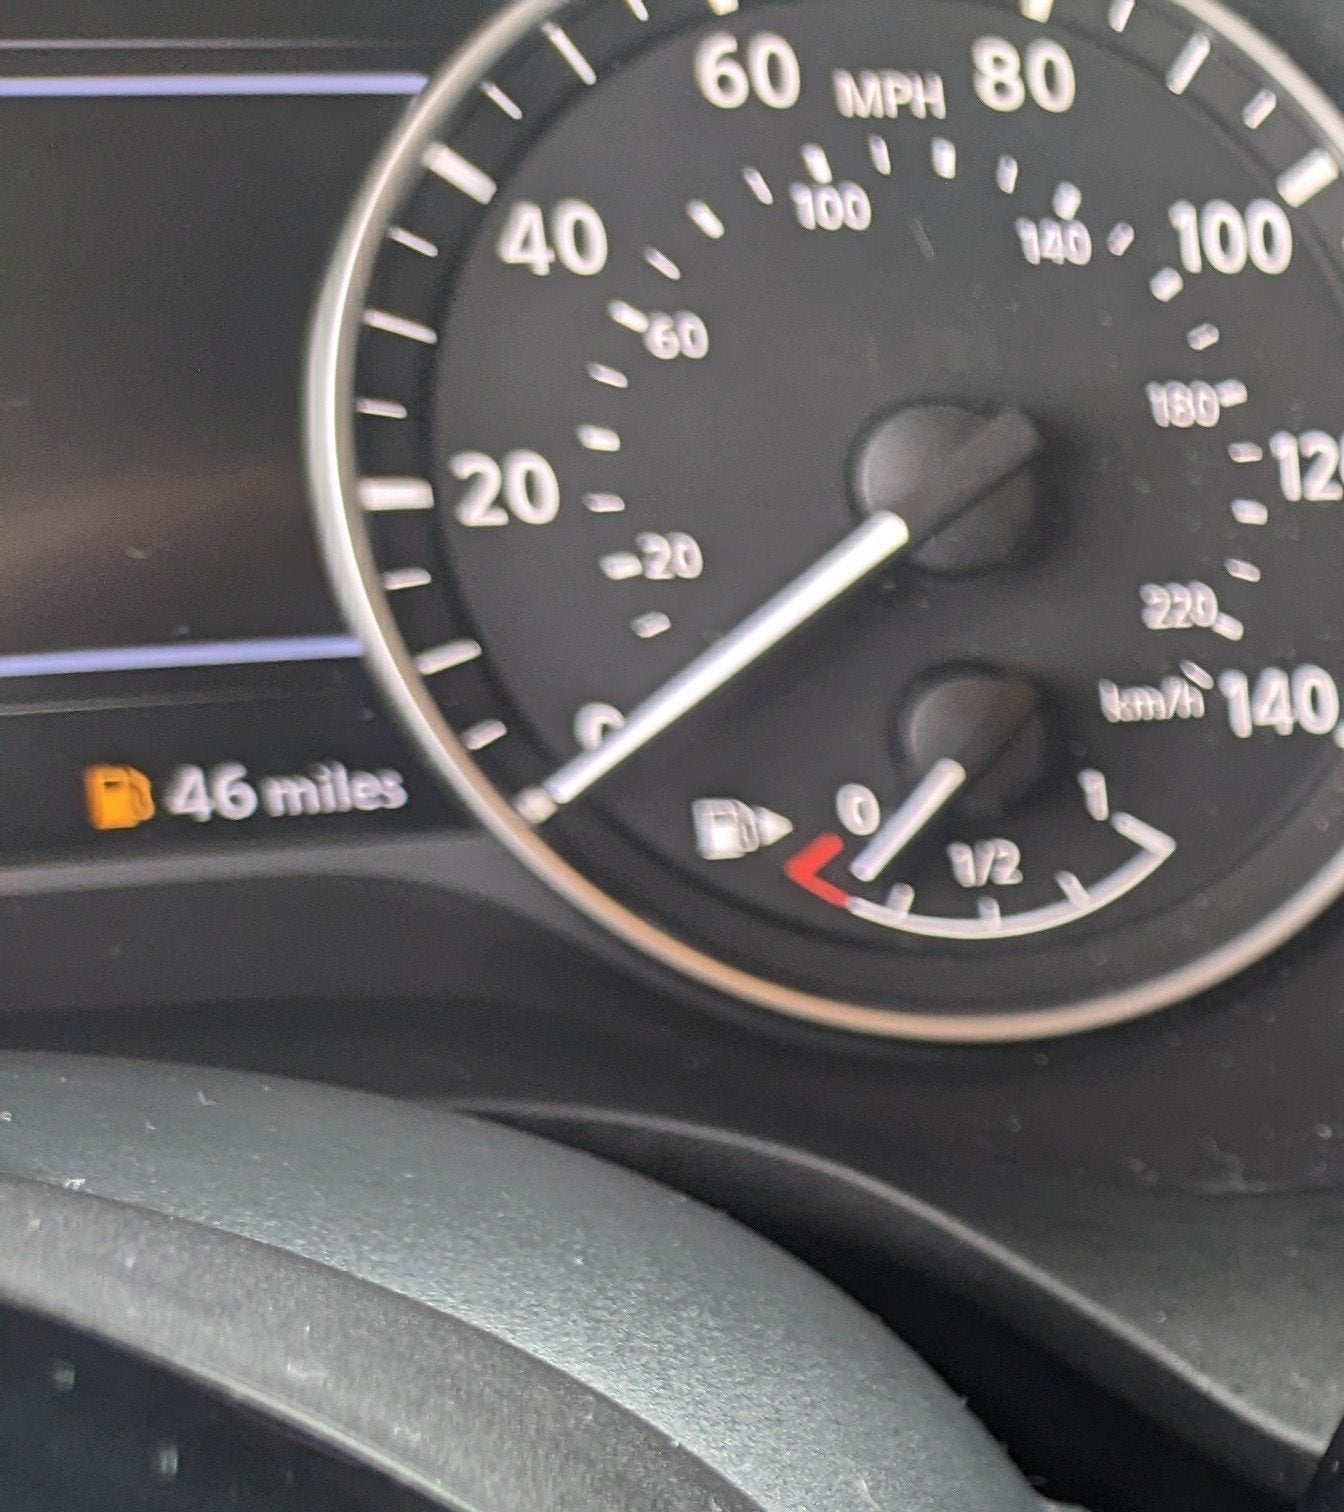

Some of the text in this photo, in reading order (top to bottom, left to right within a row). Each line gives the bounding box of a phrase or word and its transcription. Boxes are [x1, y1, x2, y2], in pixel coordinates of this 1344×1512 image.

[694, 33, 801, 110] 60
[836, 70, 946, 120] MPH
[971, 38, 1076, 113] 80
[791, 180, 872, 231] 100
[498, 200, 608, 276] 40
[1015, 216, 1091, 265] 140
[1168, 200, 1293, 275] 100
[643, 309, 709, 360] 60
[1146, 380, 1220, 428] 180
[451, 450, 560, 526] 20
[636, 532, 703, 579] 20
[1139, 580, 1218, 629] 220
[1099, 675, 1205, 722] km/h
[1218, 663, 1340, 739] 140
[163, 761, 408, 822] 46 miles
[836, 783, 881, 836] 0
[947, 838, 1023, 888] 1/2
